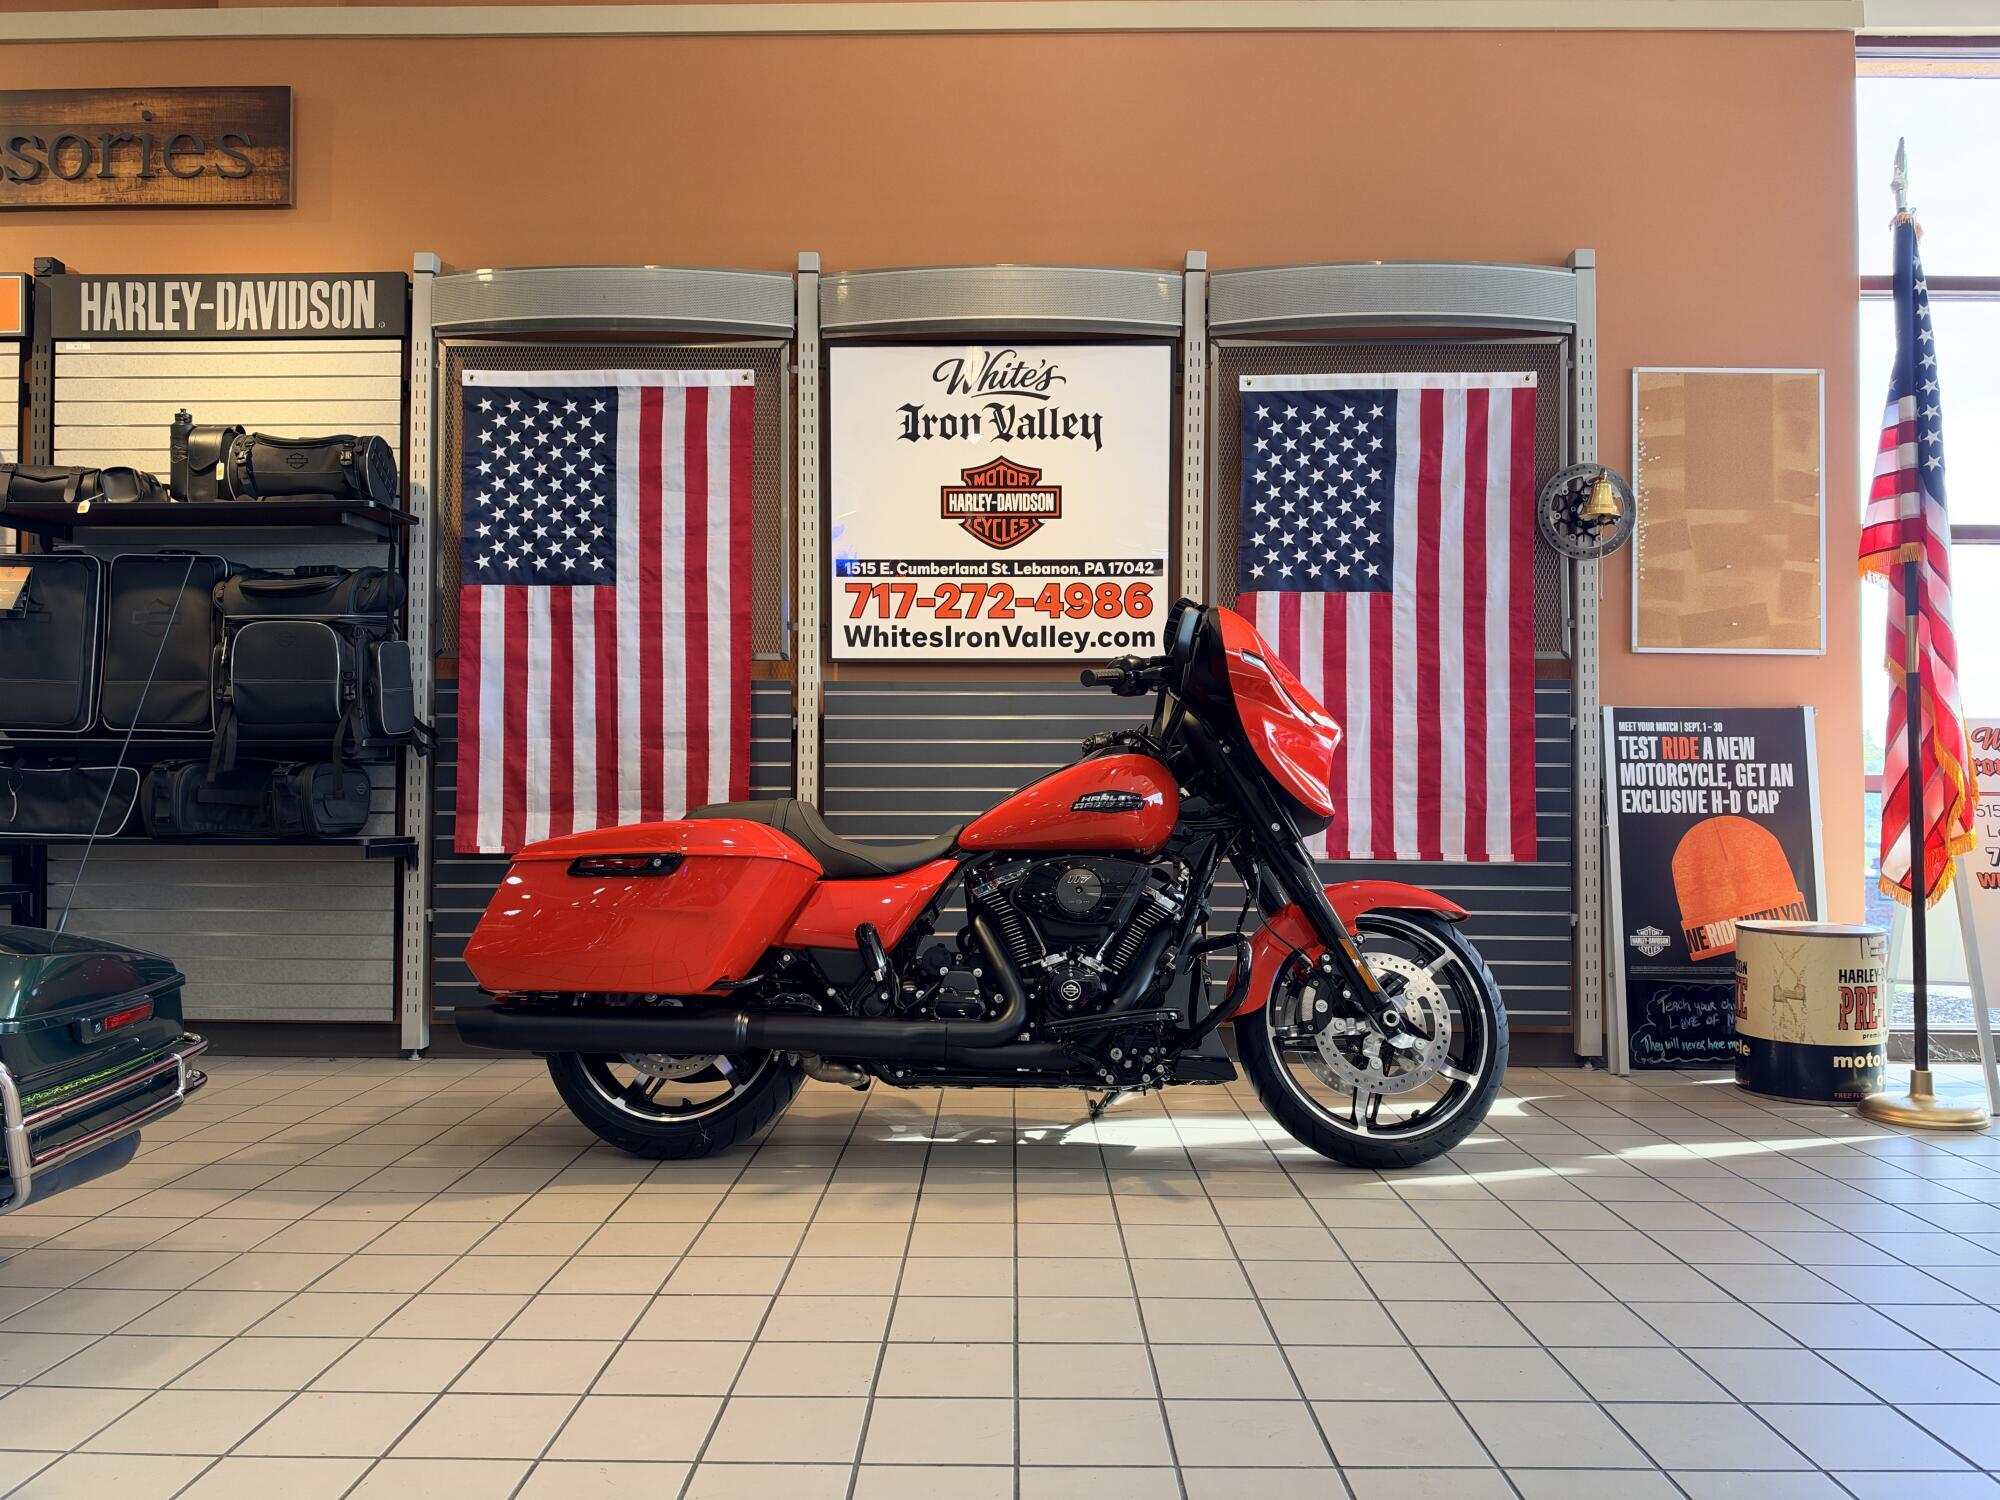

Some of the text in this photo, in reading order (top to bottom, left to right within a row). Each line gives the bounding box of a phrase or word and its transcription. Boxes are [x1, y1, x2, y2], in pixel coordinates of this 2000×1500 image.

[0, 110, 254, 181] sories
[80, 280, 376, 331] HARLEY-DAVIDSON
[932, 349, 1067, 397] White's
[896, 402, 1104, 452] Iron Valley
[973, 466, 1031, 486] MOTOR
[949, 492, 1055, 513] HARLEY-DAVIDSON
[972, 518, 1030, 543] CYCLES
[845, 562, 1155, 577] 1515 E. Cumberland St. Lebanon, PA 17042
[845, 582, 1154, 619] 717-272-4986
[844, 625, 1156, 653] WhitesIronValley.com
[1618, 721, 1637, 732] MEET
[1637, 721, 1655, 732] YOUR
[1656, 721, 1679, 732] MATCH
[1684, 722, 1702, 732] SEPT.
[1702, 722, 1707, 733] 1
[1713, 722, 1723, 733] 30
[1618, 735, 1755, 760] TEST RIDE A NEW
[1620, 762, 1794, 789] MOTORCYCLE, GET AN
[1621, 789, 1708, 814] EXCLUSIVE
[1838, 968, 1885, 984] HARLEY-
[1838, 985, 1886, 1031] PRE-
